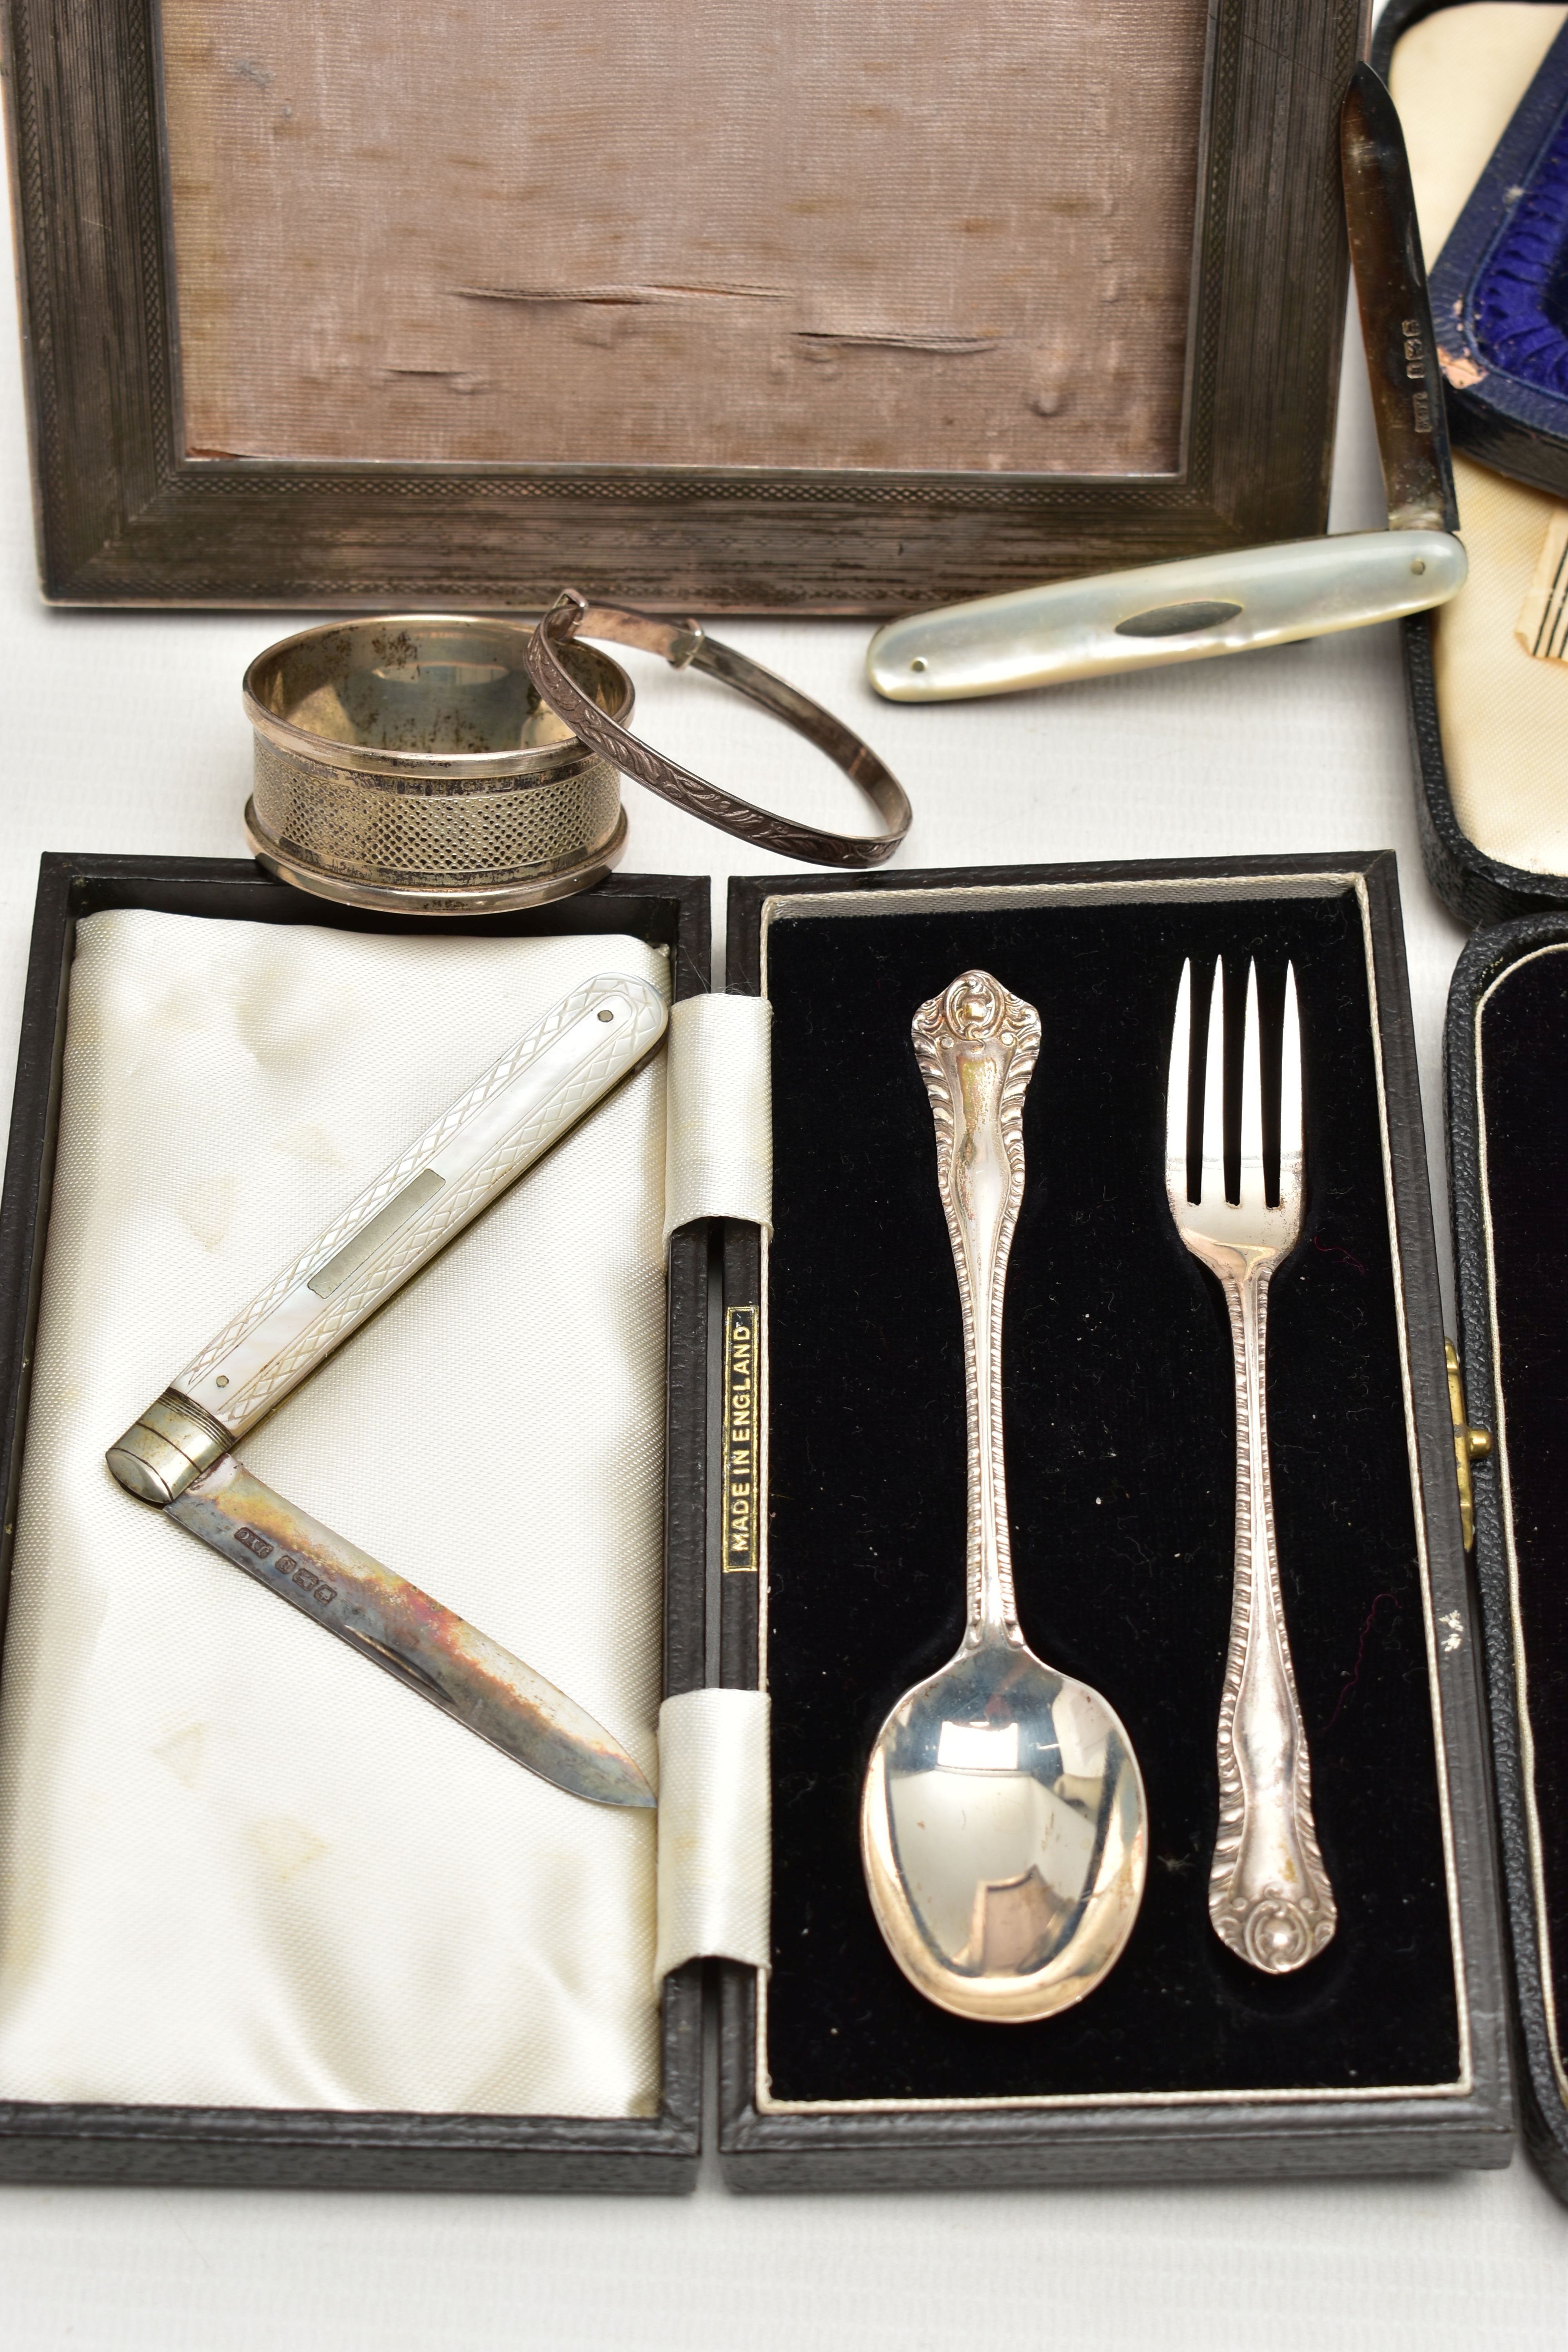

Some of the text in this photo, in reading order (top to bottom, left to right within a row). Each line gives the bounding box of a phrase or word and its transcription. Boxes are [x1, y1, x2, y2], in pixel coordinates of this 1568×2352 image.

[731, 1326, 751, 1551] MADE IN ENGLAND
